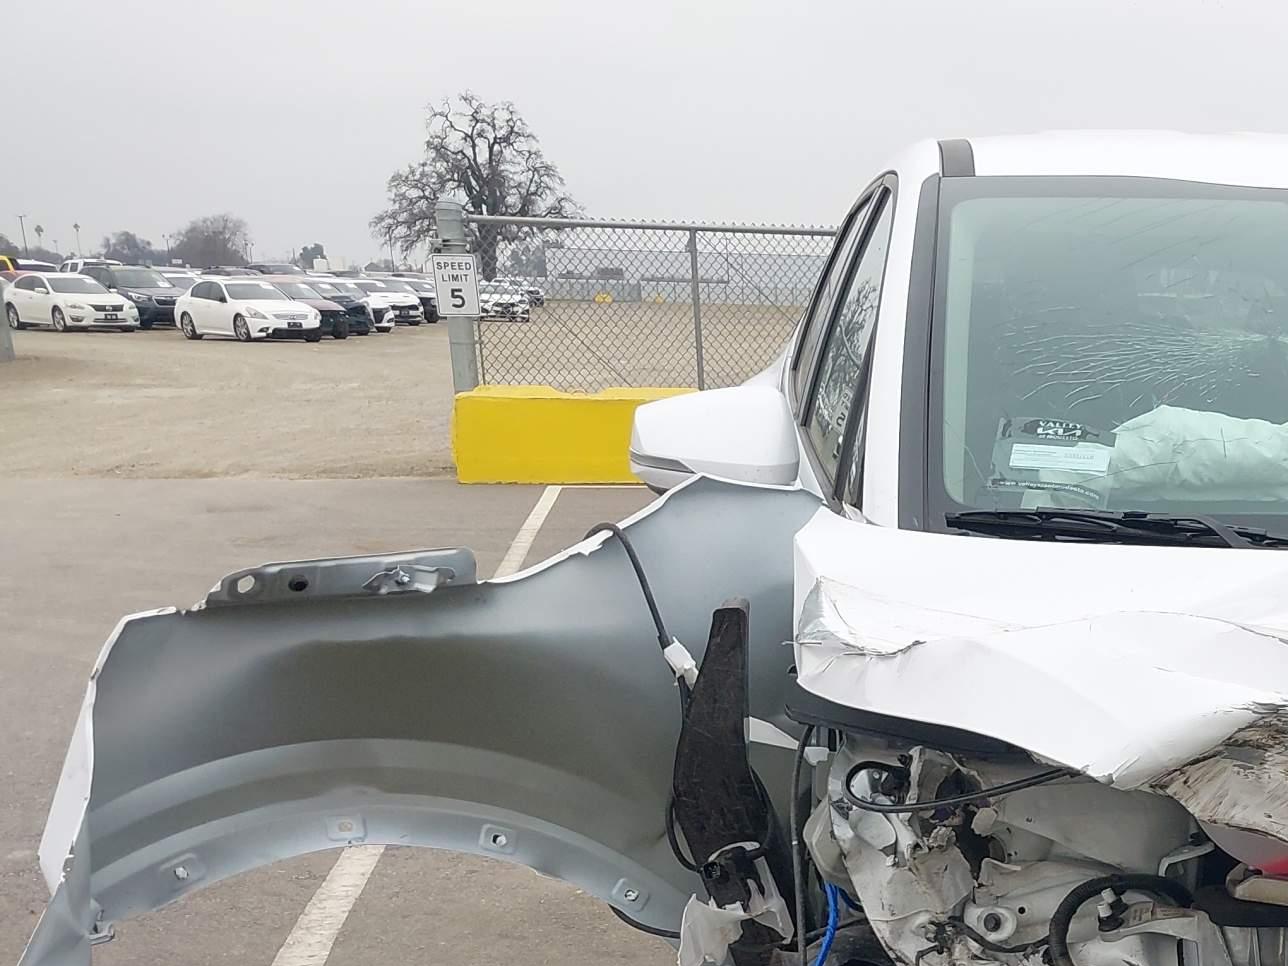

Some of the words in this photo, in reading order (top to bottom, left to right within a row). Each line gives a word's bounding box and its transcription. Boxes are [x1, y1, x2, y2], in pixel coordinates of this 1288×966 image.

[436, 261, 472, 271] SPEED
[441, 273, 469, 283] LIMIT
[450, 287, 466, 309] 5
[1039, 421, 1082, 429] VALLEY
